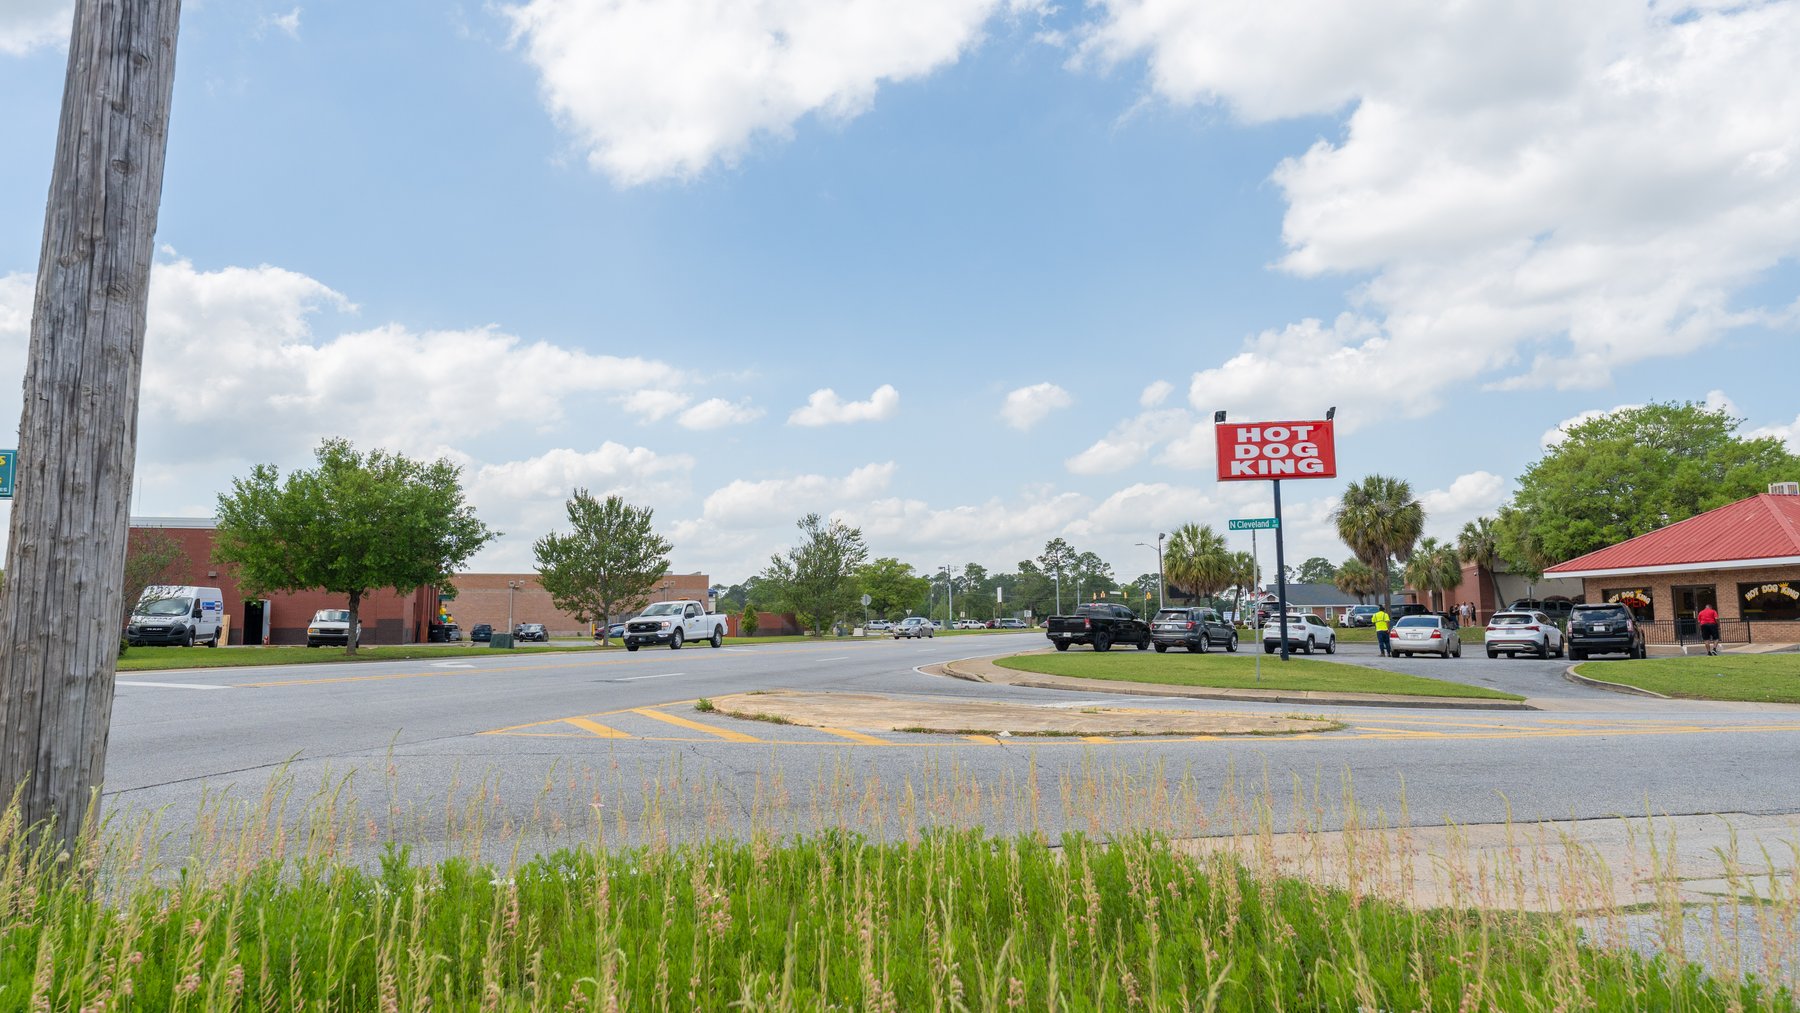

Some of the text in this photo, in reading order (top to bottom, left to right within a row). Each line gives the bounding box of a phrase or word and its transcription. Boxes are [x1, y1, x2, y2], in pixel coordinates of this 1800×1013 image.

[1236, 425, 1314, 443] HOT
[1234, 442, 1319, 459] DOG
[1230, 458, 1324, 476] KING
[1229, 520, 1236, 529] N
[1237, 519, 1270, 529] Cleveland
[1608, 591, 1651, 605] HOT DOG KING
[1744, 584, 1800, 601] HOT DOG KING
[1619, 597, 1646, 608] OPEN
